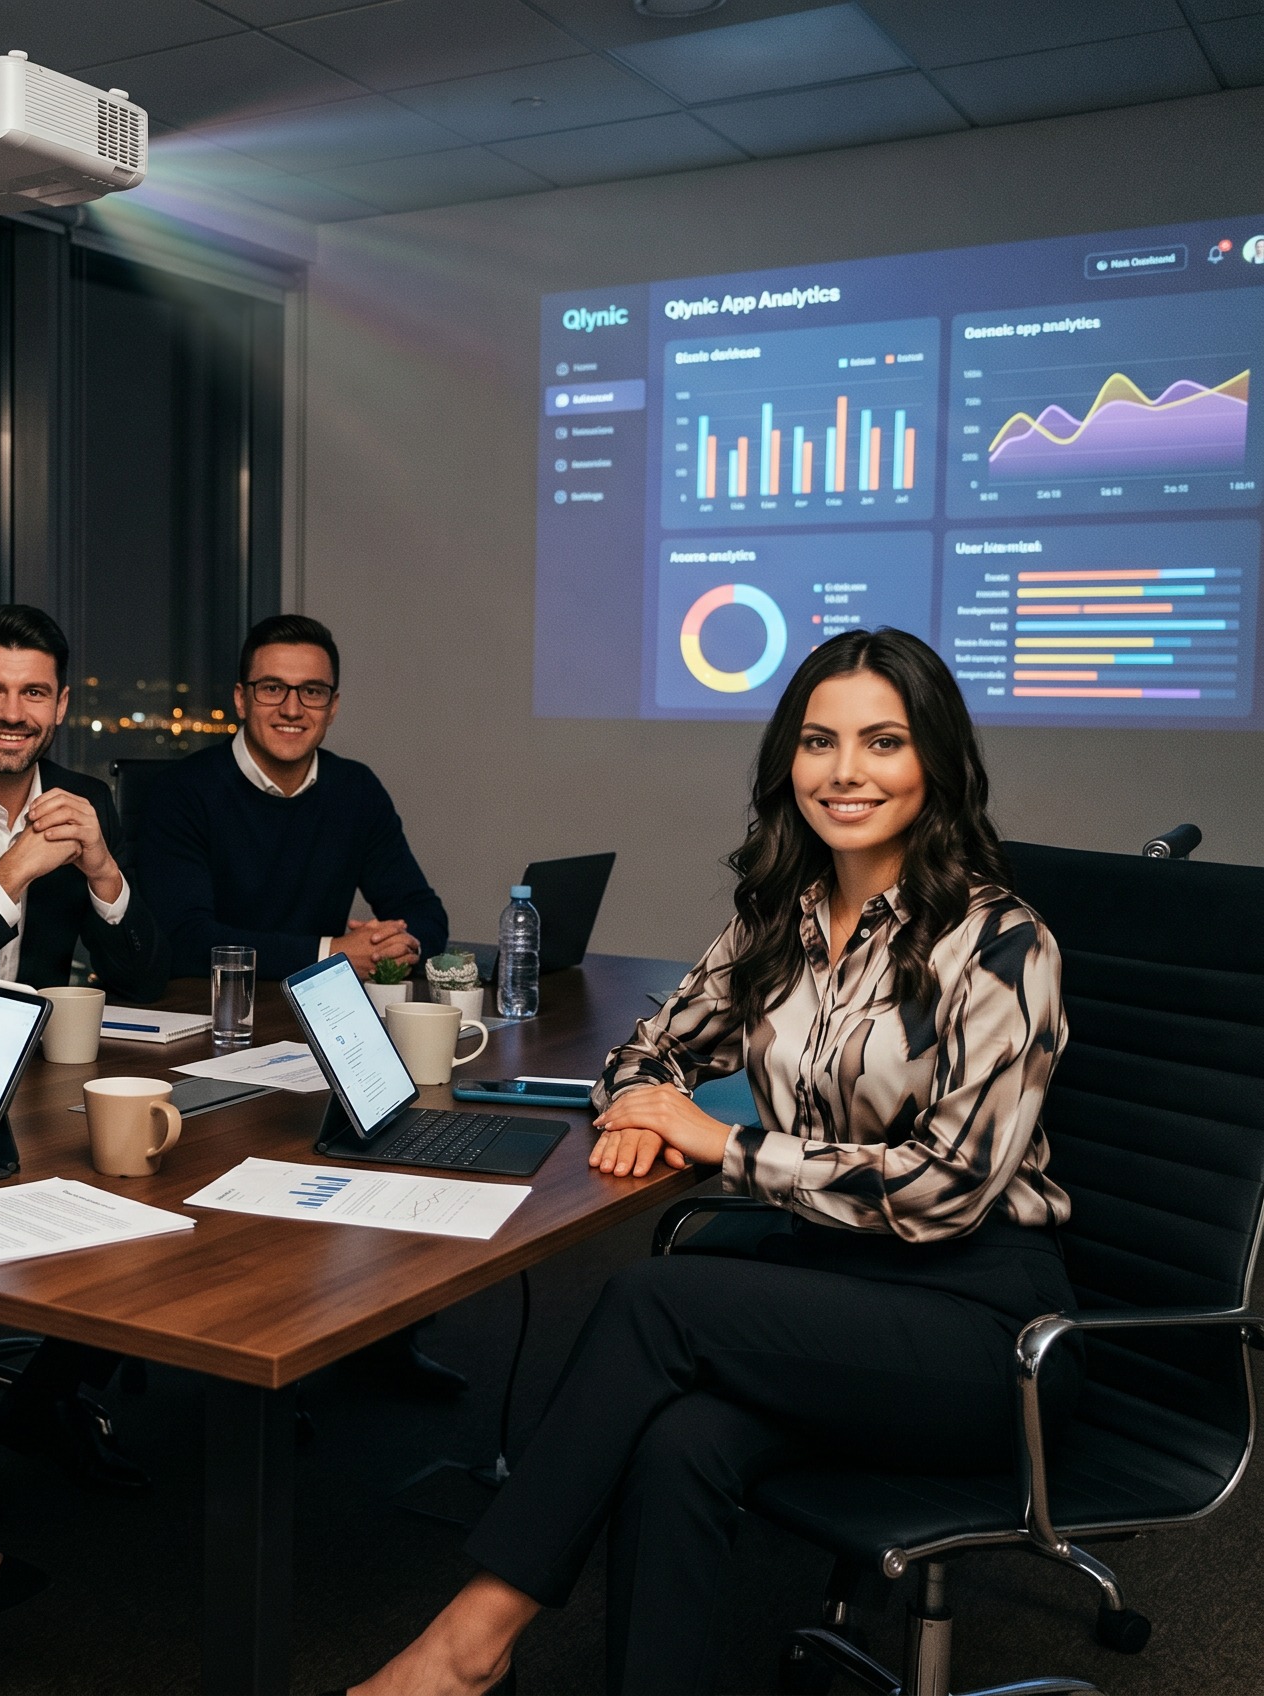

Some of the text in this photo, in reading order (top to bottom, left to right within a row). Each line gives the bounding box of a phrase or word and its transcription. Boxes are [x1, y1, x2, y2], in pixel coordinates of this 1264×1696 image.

[665, 285, 841, 320] Qlynic App Analytics
[562, 305, 629, 333] Qlynic
